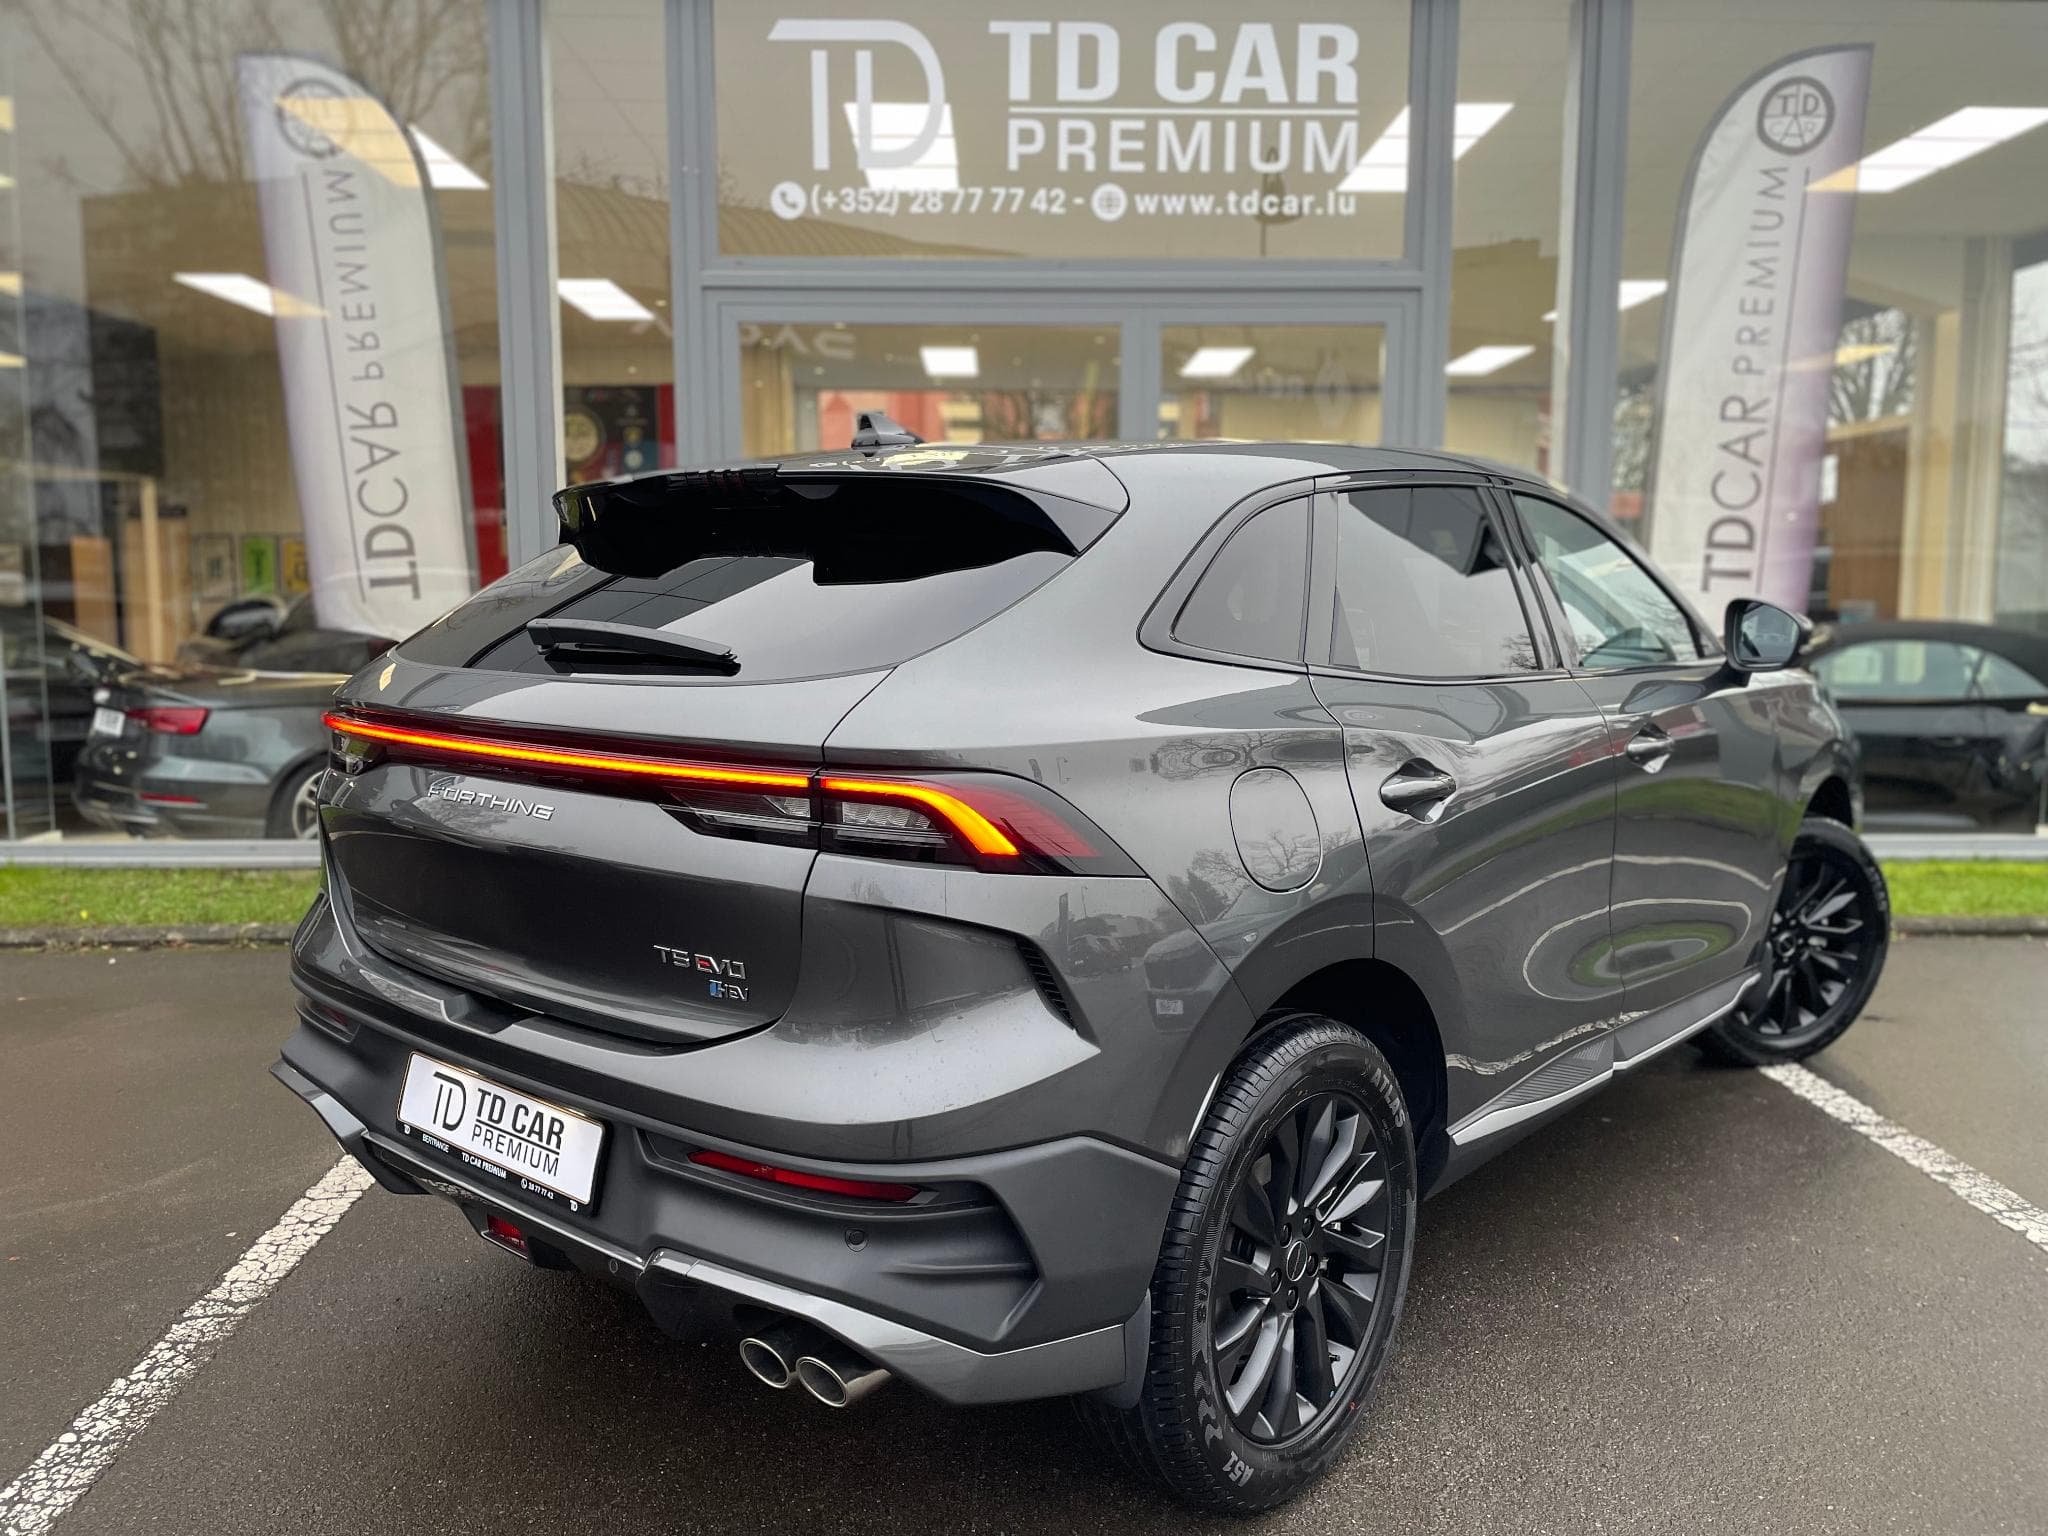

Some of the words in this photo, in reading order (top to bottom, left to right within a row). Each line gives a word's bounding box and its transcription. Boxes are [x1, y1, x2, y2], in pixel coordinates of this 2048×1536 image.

[989, 21, 1120, 101] TD
[1154, 22, 1360, 103] CAR
[1007, 118, 1360, 172] PREMIUM
[811, 183, 900, 216] (+352)
[908, 186, 944, 214] 28
[950, 187, 983, 214] 77
[991, 187, 1025, 214] 77
[1030, 187, 1067, 214] 42
[1134, 188, 1357, 217] www.tdcar.lu
[1731, 166, 1790, 376] PREMIUM
[1701, 395, 1771, 592] TDCAR
[427, 785, 555, 820] FORTHING
[694, 953, 746, 979] EVO
[476, 1088, 506, 1124] TD
[511, 1104, 565, 1150] CAR
[1370, 1067, 1406, 1128] ATLAS
[471, 1124, 560, 1177] PREMIUM
[1222, 1450, 1254, 1487] A51
